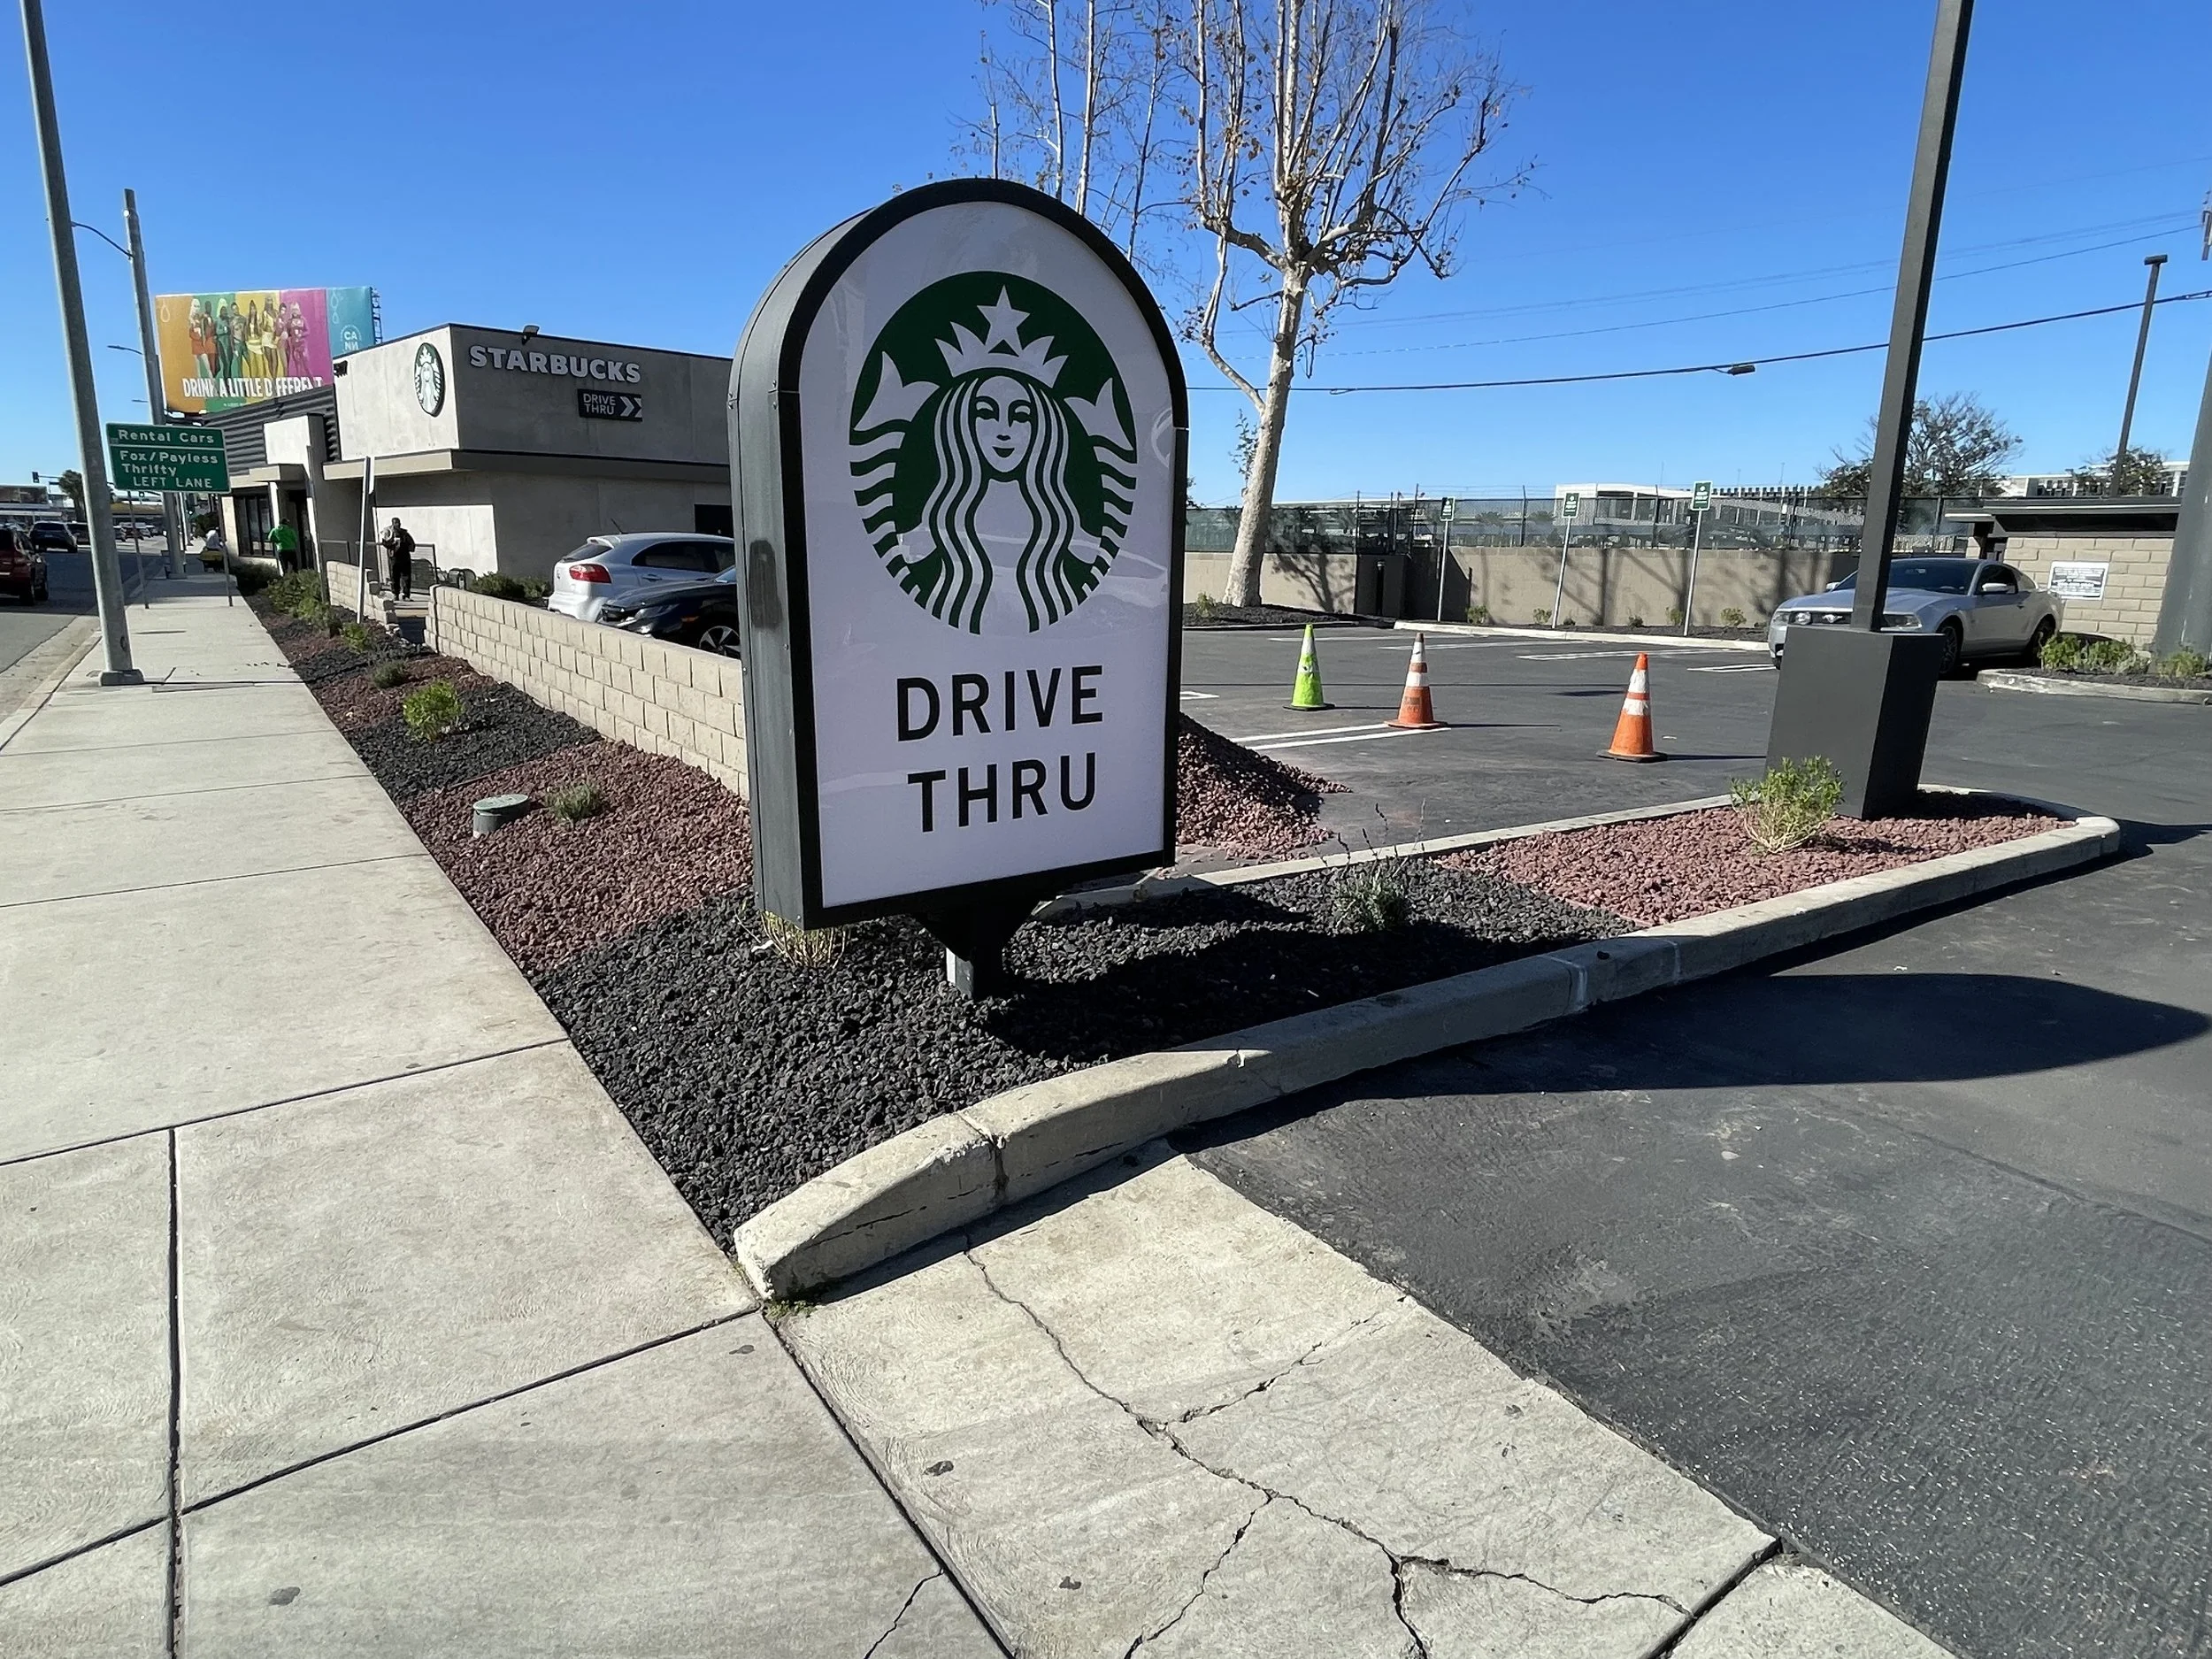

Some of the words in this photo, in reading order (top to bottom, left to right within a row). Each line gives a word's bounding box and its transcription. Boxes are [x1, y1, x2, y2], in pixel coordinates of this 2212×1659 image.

[343, 331, 358, 341] CA
[469, 345, 641, 384] STARBUCKS
[219, 377, 228, 397] A
[227, 377, 264, 397] LITTLE
[583, 393, 617, 406] DRIVE
[584, 403, 615, 415] THRU
[118, 429, 171, 442] Rental
[179, 433, 214, 443] Cars
[119, 450, 219, 465] Fox/Payless
[121, 463, 177, 477] Thrifty
[133, 476, 166, 487] LEFT
[175, 478, 213, 488] LANE
[896, 664, 1103, 742] DRIVE
[907, 751, 1096, 833] THRU
